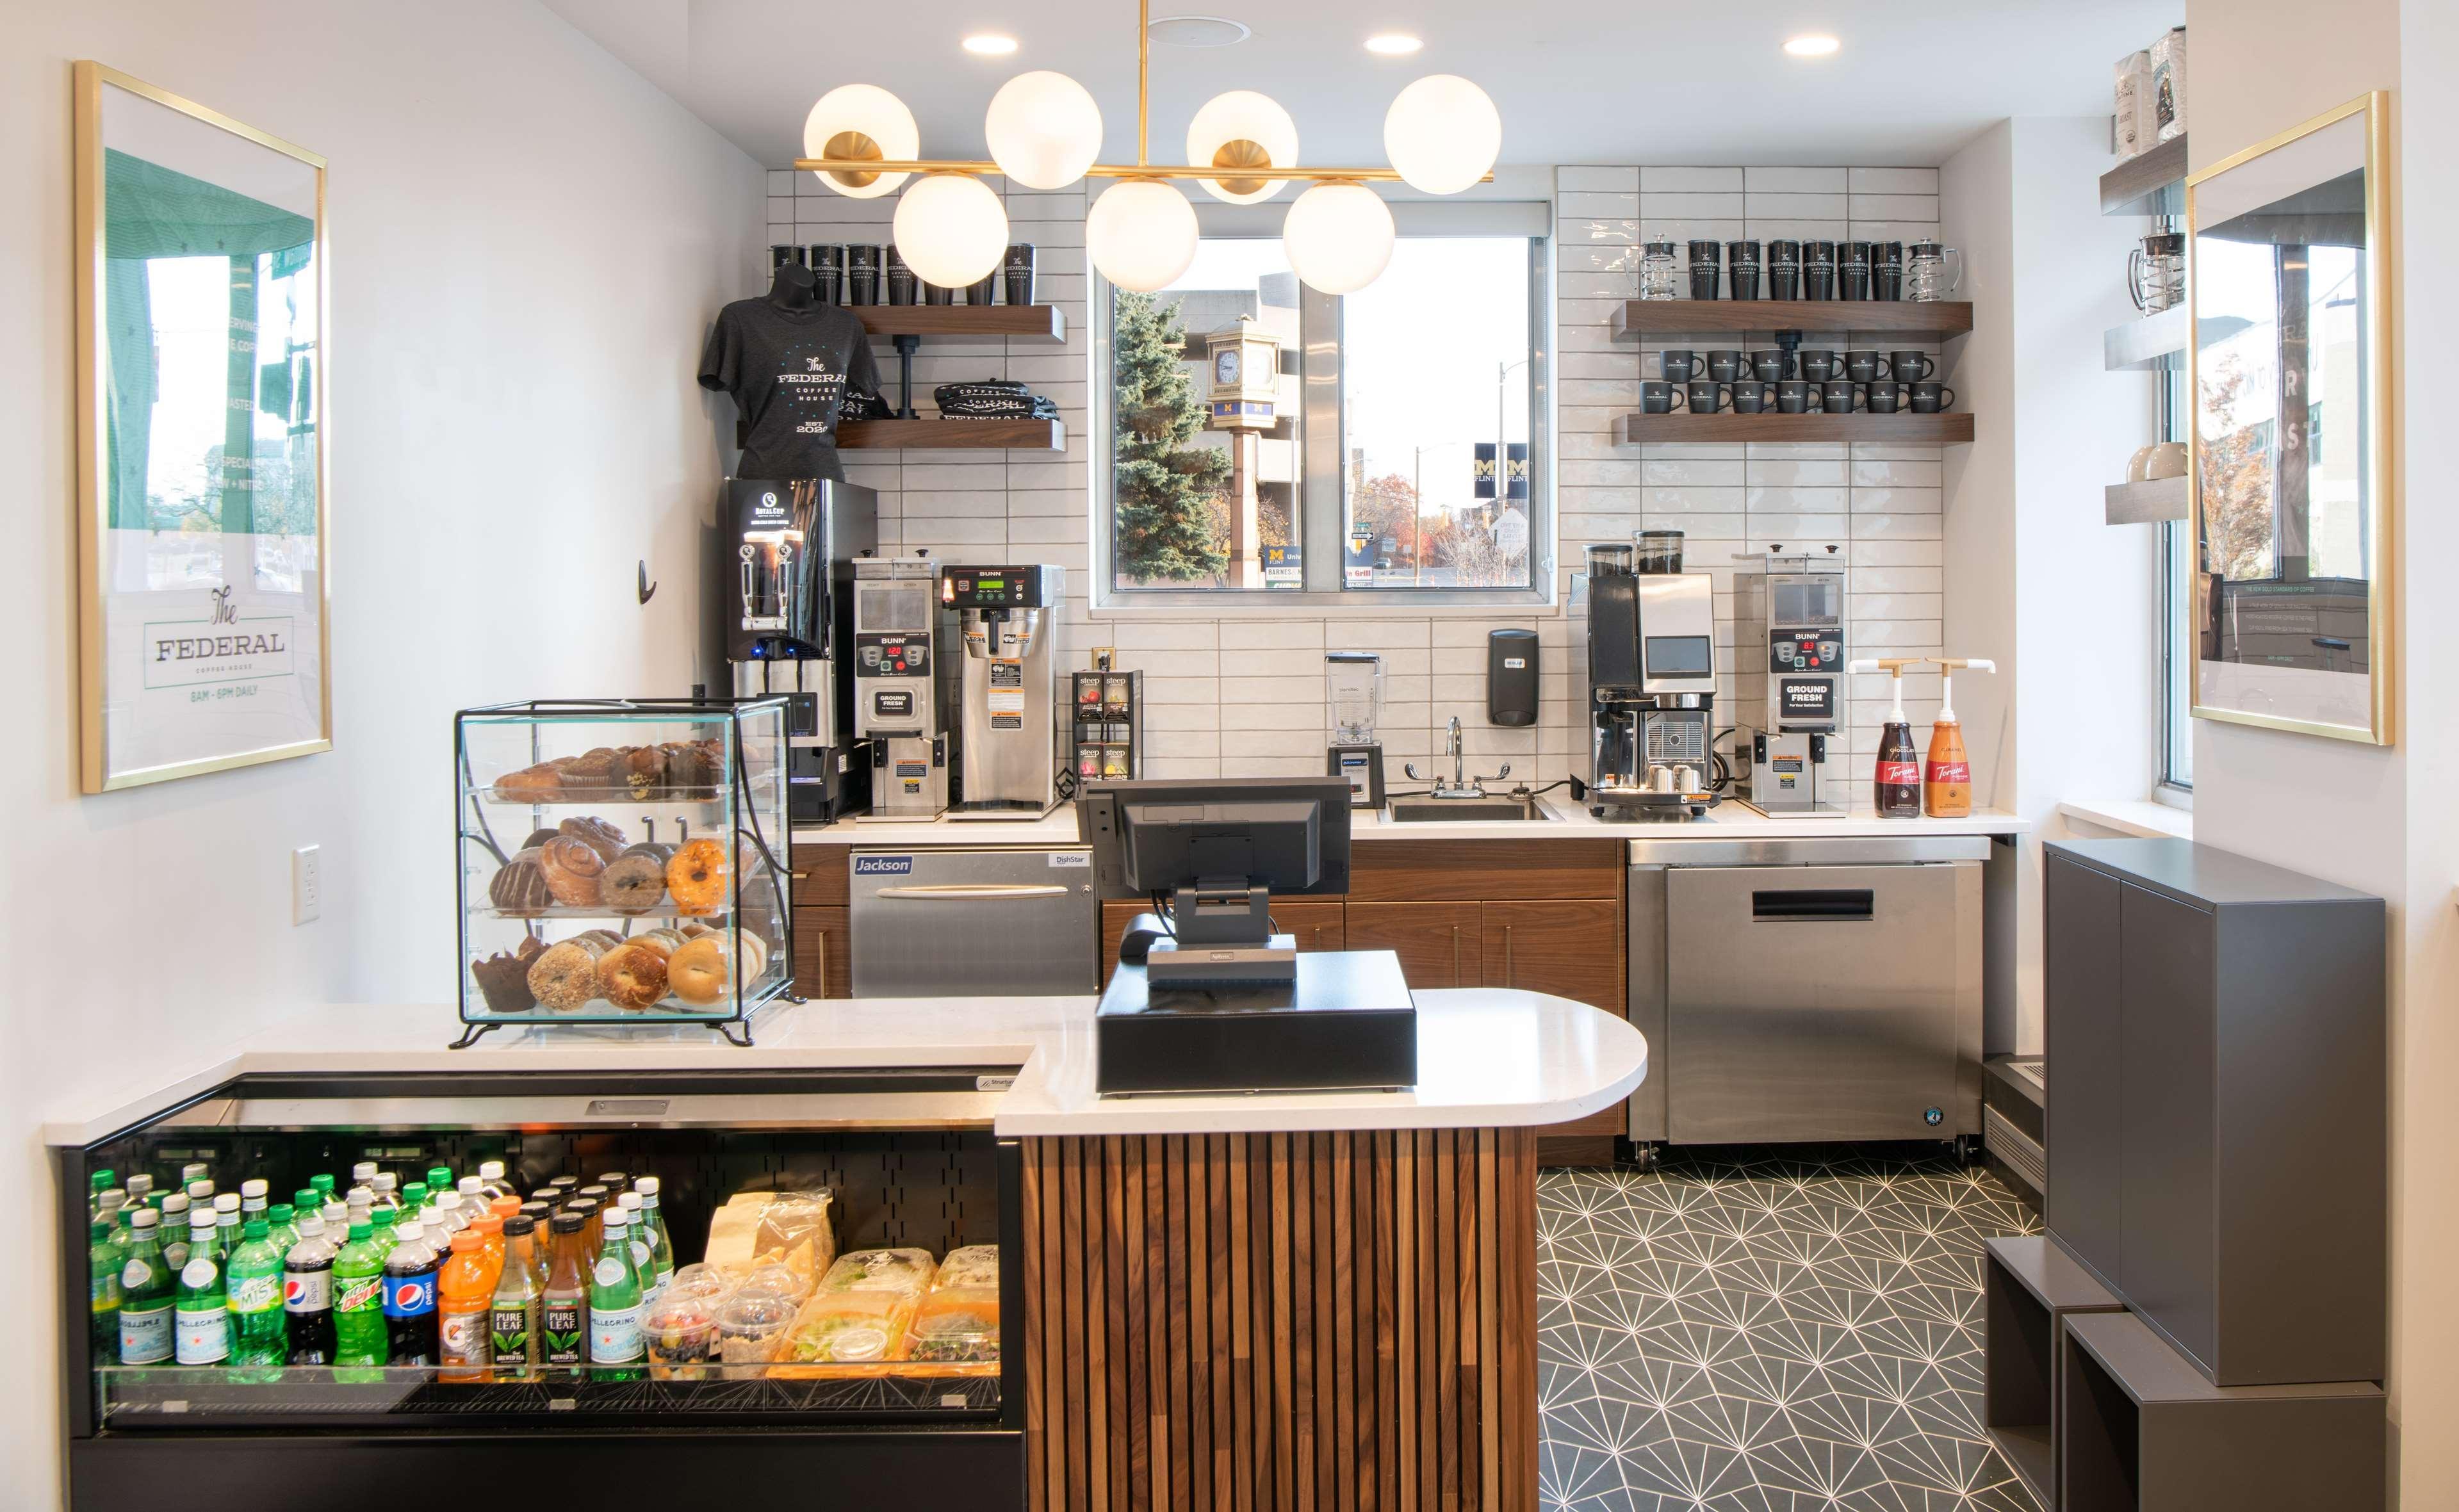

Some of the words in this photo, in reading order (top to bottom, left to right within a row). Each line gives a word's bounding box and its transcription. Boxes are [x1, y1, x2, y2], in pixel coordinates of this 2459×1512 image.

[806, 357, 826, 371] The
[776, 374, 847, 384] FEDERAL
[1475, 459, 1496, 476] M
[1507, 459, 1528, 476] M
[1269, 549, 1284, 560] M
[210, 585, 238, 625] The
[156, 633, 284, 662] FEDERAL
[196, 665, 225, 674] COFFEE
[236, 685, 258, 697] DAILY
[1080, 749, 1100, 757] steep
[1106, 749, 1125, 757] steep
[1888, 765, 1915, 780] Torani
[1937, 765, 1964, 779] Torani
[856, 859, 910, 872] Jackson
[241, 1280, 278, 1310] MIST
[309, 1281, 319, 1305] pepsi
[424, 1281, 434, 1305] pepsi
[496, 1312, 523, 1321] PURE
[550, 1312, 575, 1321] PURE
[443, 1318, 466, 1347] G
